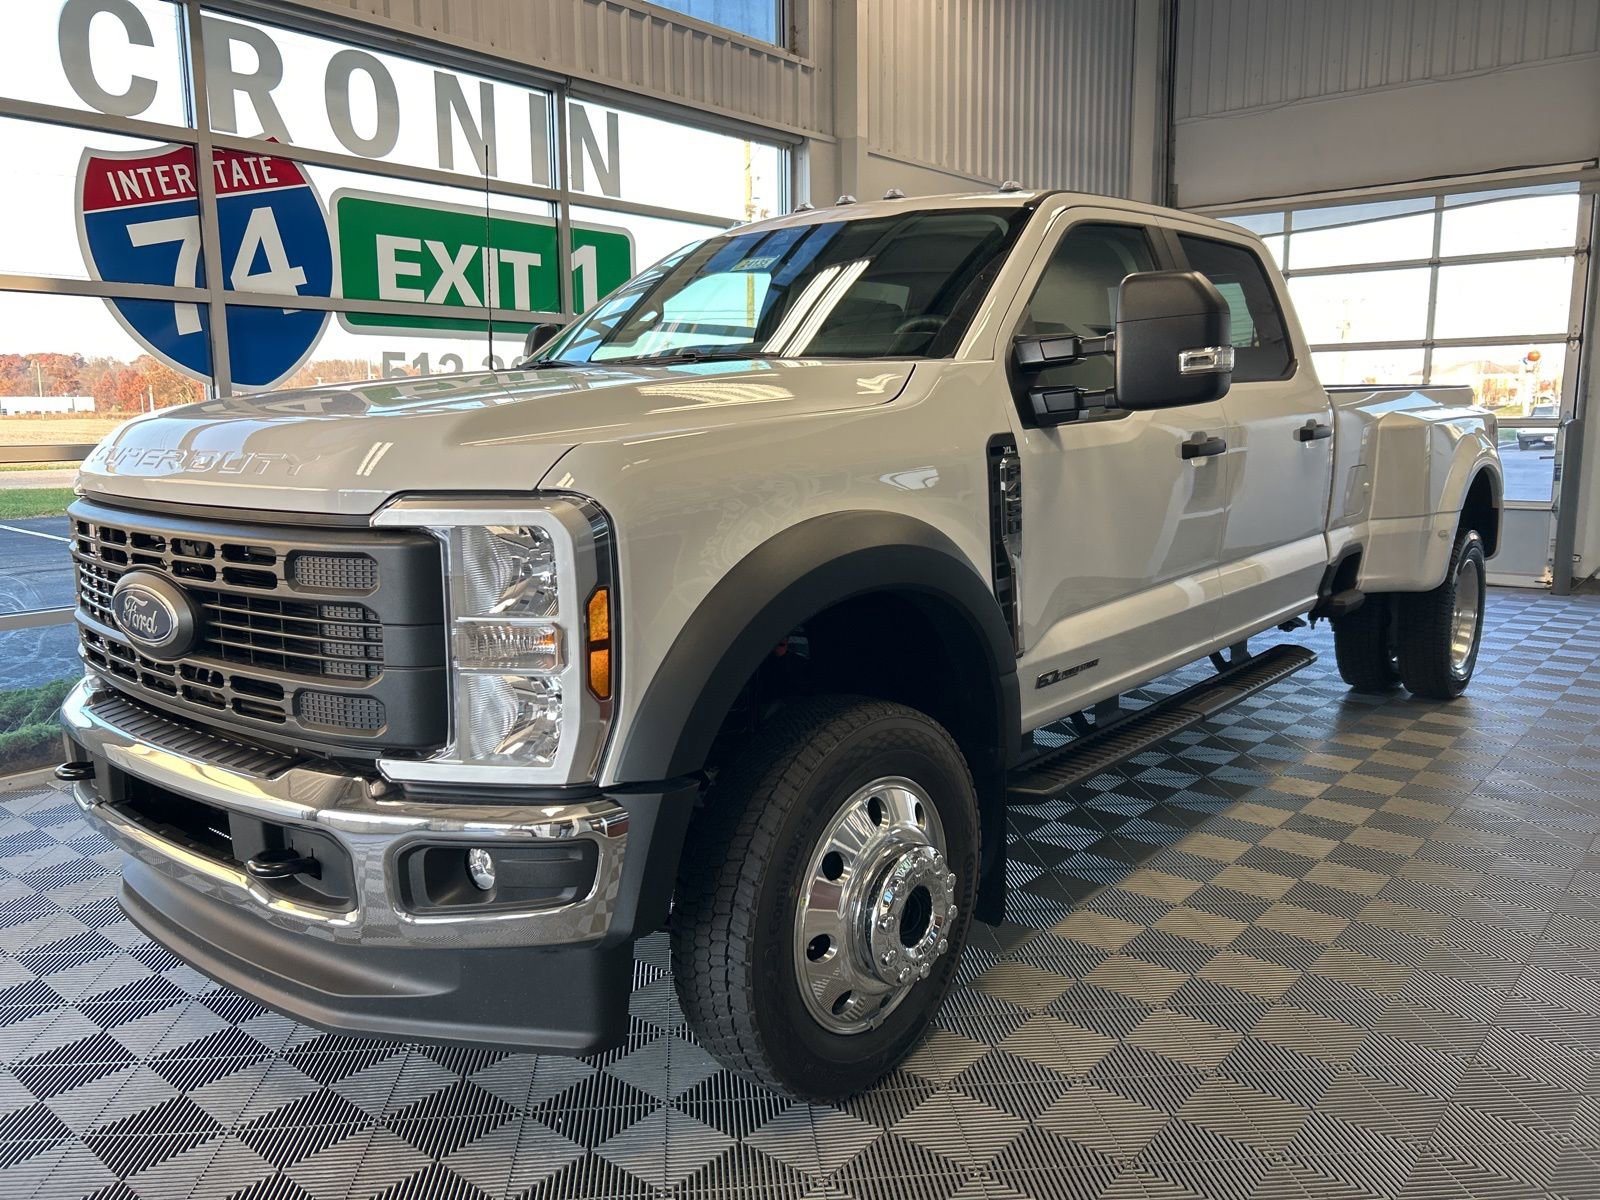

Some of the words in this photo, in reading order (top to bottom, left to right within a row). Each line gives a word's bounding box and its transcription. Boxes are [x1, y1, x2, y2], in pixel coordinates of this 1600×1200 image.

[57, 0, 622, 199] CRONIN
[106, 156, 279, 202] INTERTATE
[125, 206, 308, 336] 74
[375, 234, 542, 312] EXIT
[571, 244, 598, 315] 1
[185, 449, 320, 475] DUTY
[123, 595, 158, 634] Ford
